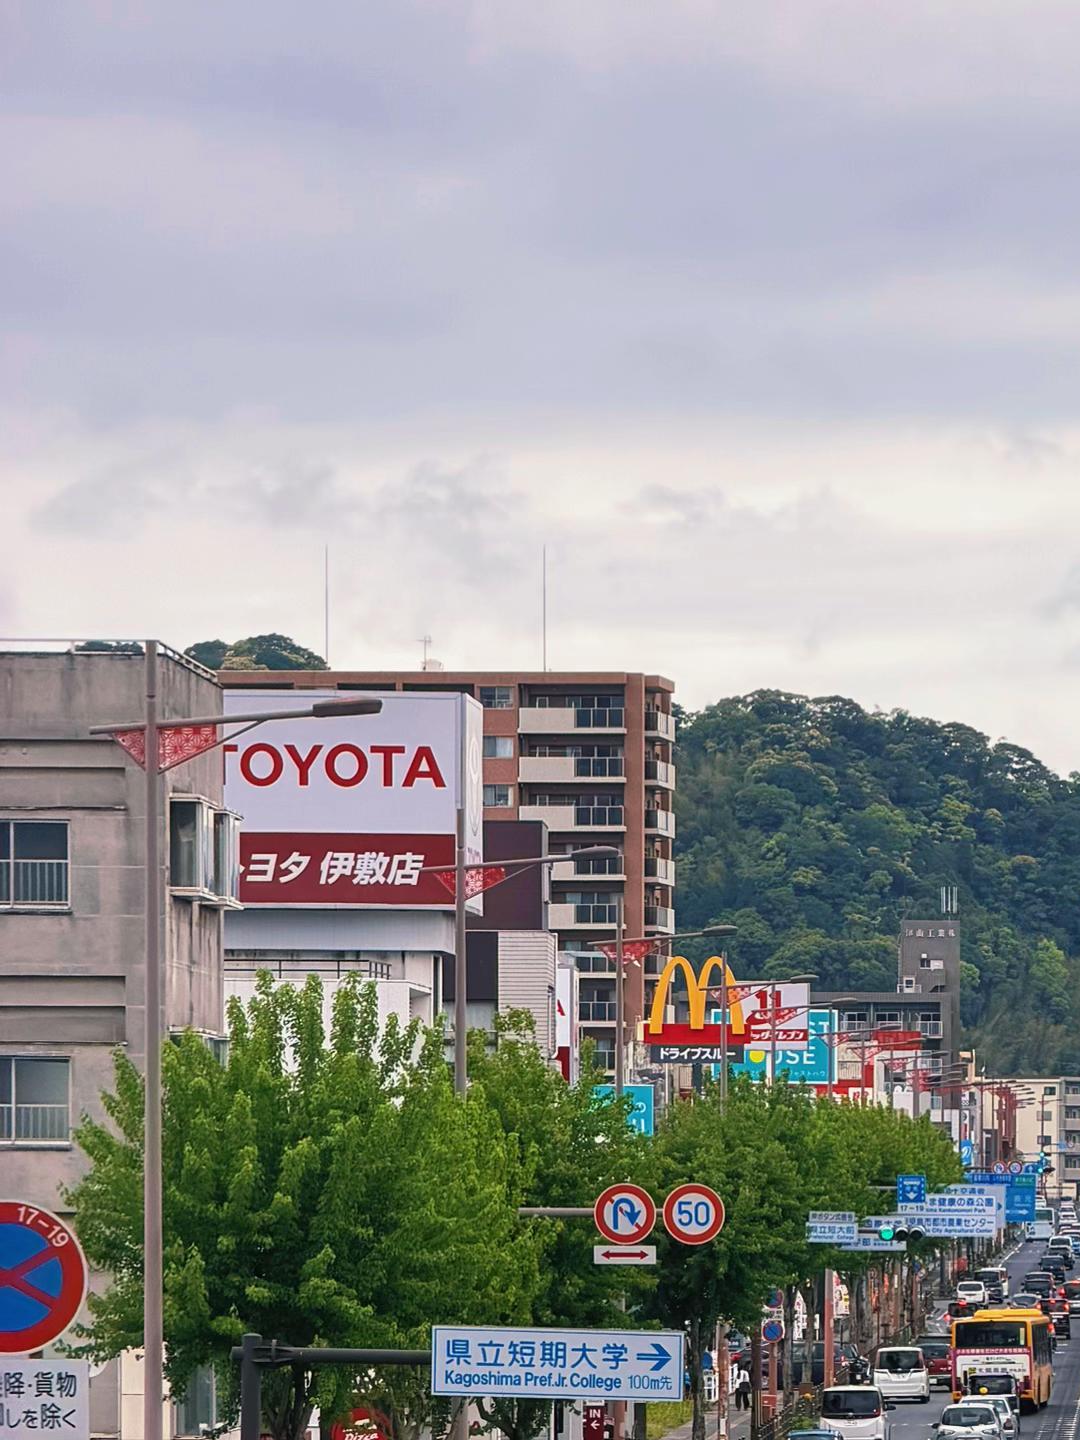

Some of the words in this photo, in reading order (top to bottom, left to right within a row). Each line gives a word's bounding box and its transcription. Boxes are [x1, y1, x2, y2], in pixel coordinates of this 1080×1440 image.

[240, 851, 311, 884] ヨタ
[319, 851, 425, 886] 伊敷店
[677, 1201, 711, 1227] 50
[445, 1339, 629, 1371] 県立短期大学
[0, 1371, 77, 1398] 降・貨物
[444, 1371, 522, 1389] Kagoshima
[570, 1373, 622, 1390] College
[627, 1374, 673, 1391] 100m先
[589, 1409, 601, 1418] IN
